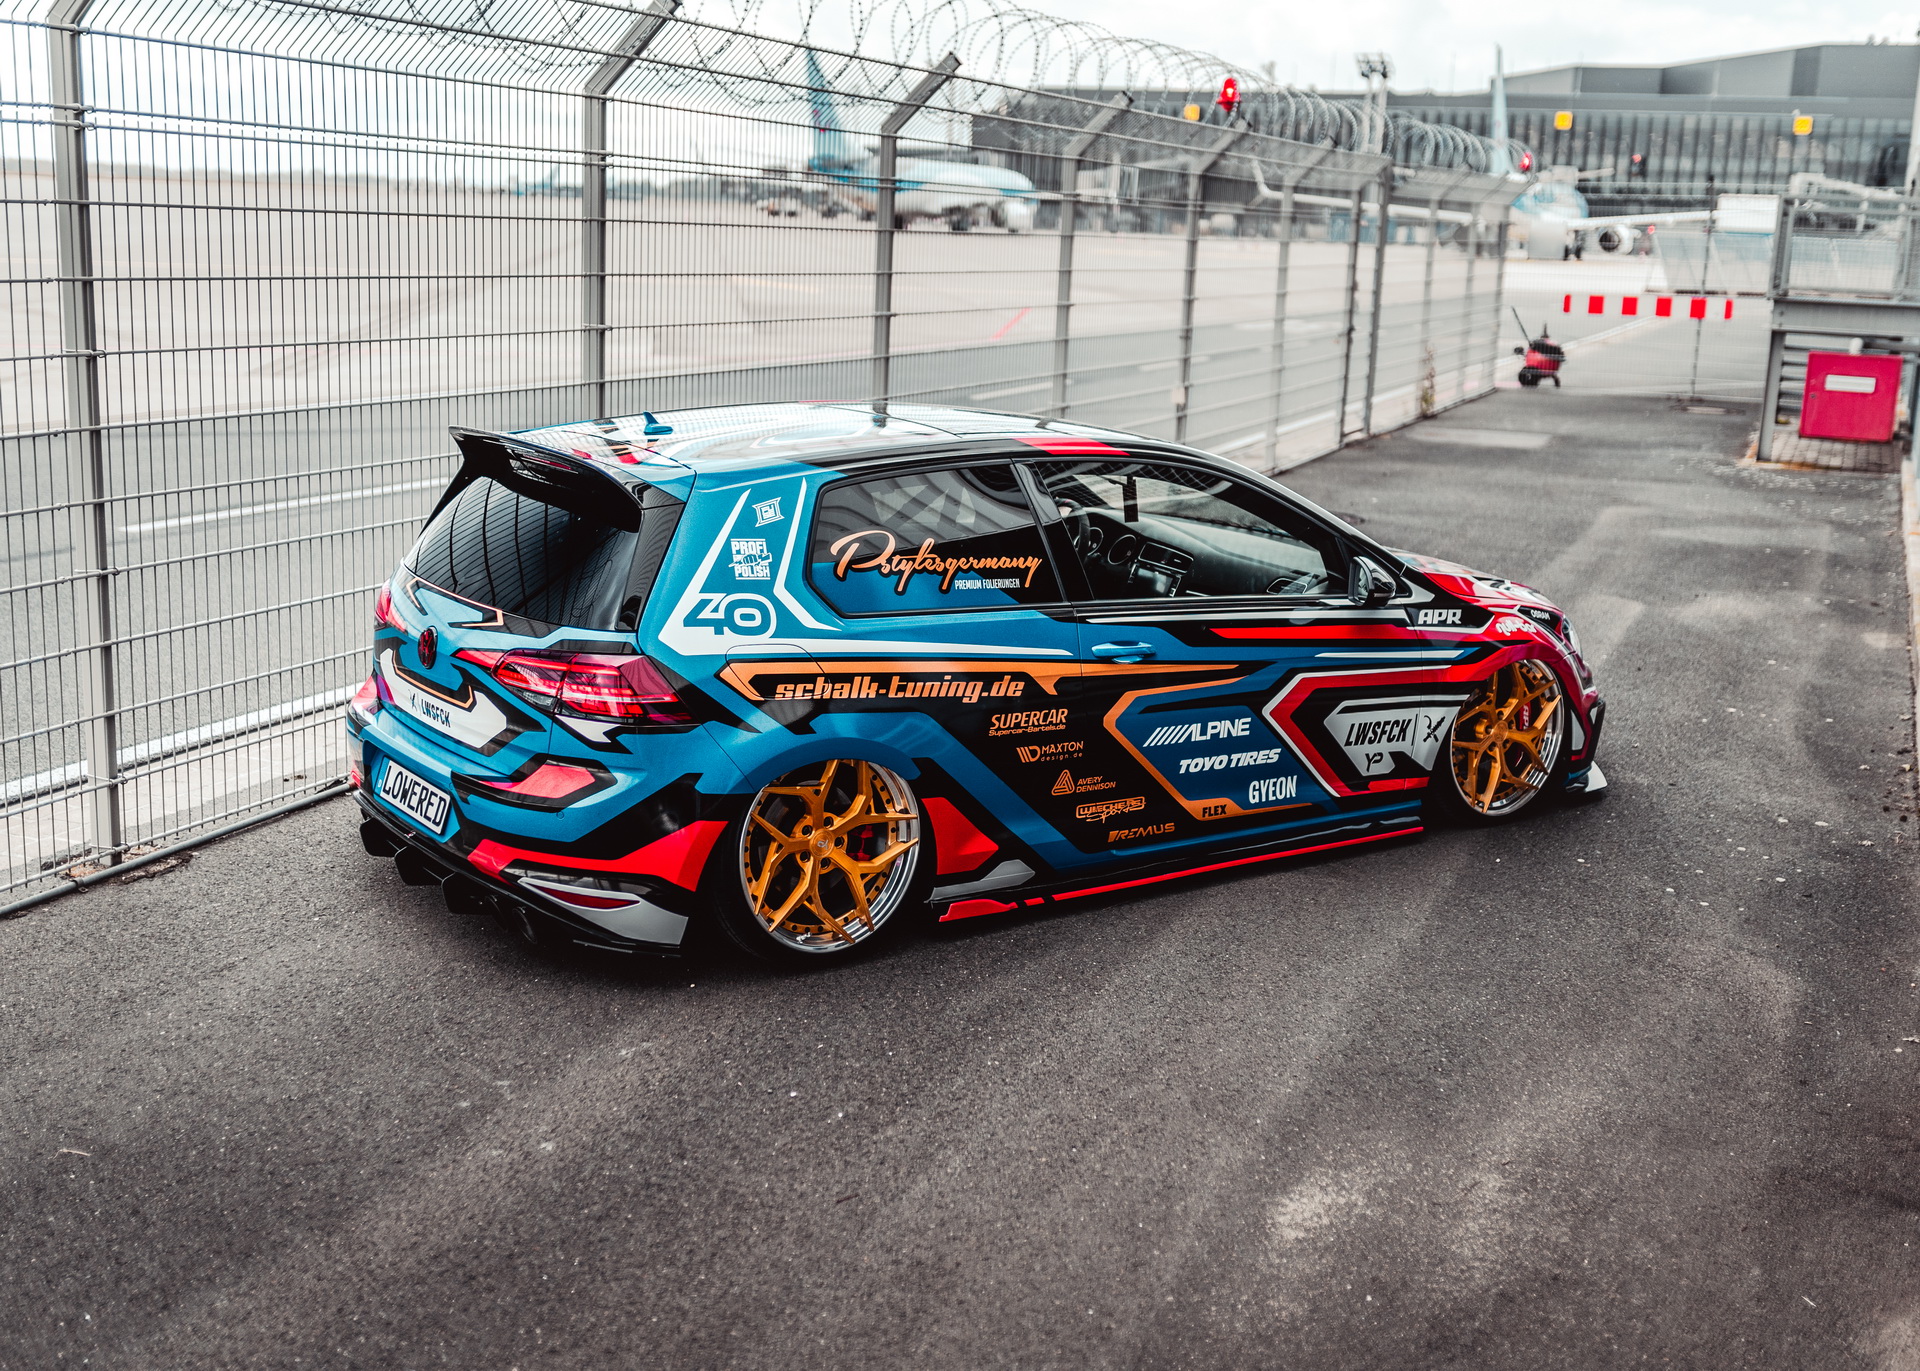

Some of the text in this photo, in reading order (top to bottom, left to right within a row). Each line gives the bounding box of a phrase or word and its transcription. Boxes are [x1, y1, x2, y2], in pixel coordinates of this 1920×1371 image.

[731, 541, 767, 555] PROFI
[830, 530, 1043, 592] Pstylesgermany
[734, 566, 770, 577] POLISH
[954, 578, 1021, 590] PREMIUM FOLIERUNGEN
[683, 598, 772, 636] 40
[1418, 609, 1462, 625] APR
[1530, 609, 1551, 620] OSRAM
[775, 675, 1025, 703] schalk-tuning.de
[421, 698, 451, 728] LWSFCK
[990, 708, 1068, 730] SUPERCAR
[988, 724, 1066, 737] Supercar-Bartels.de
[1177, 717, 1252, 743] ALPINE
[1344, 718, 1412, 747] LWSFCK
[1041, 740, 1084, 755] MAXTON
[1040, 751, 1083, 762] design.de
[1179, 748, 1282, 774] TOYO TIRES
[1075, 781, 1117, 793] DENNISON
[1077, 775, 1103, 785] AVERY
[382, 765, 447, 828] LOWERED
[1248, 774, 1298, 804] GYEON
[1202, 803, 1228, 818] FLEX
[1115, 822, 1175, 841] REMUS
